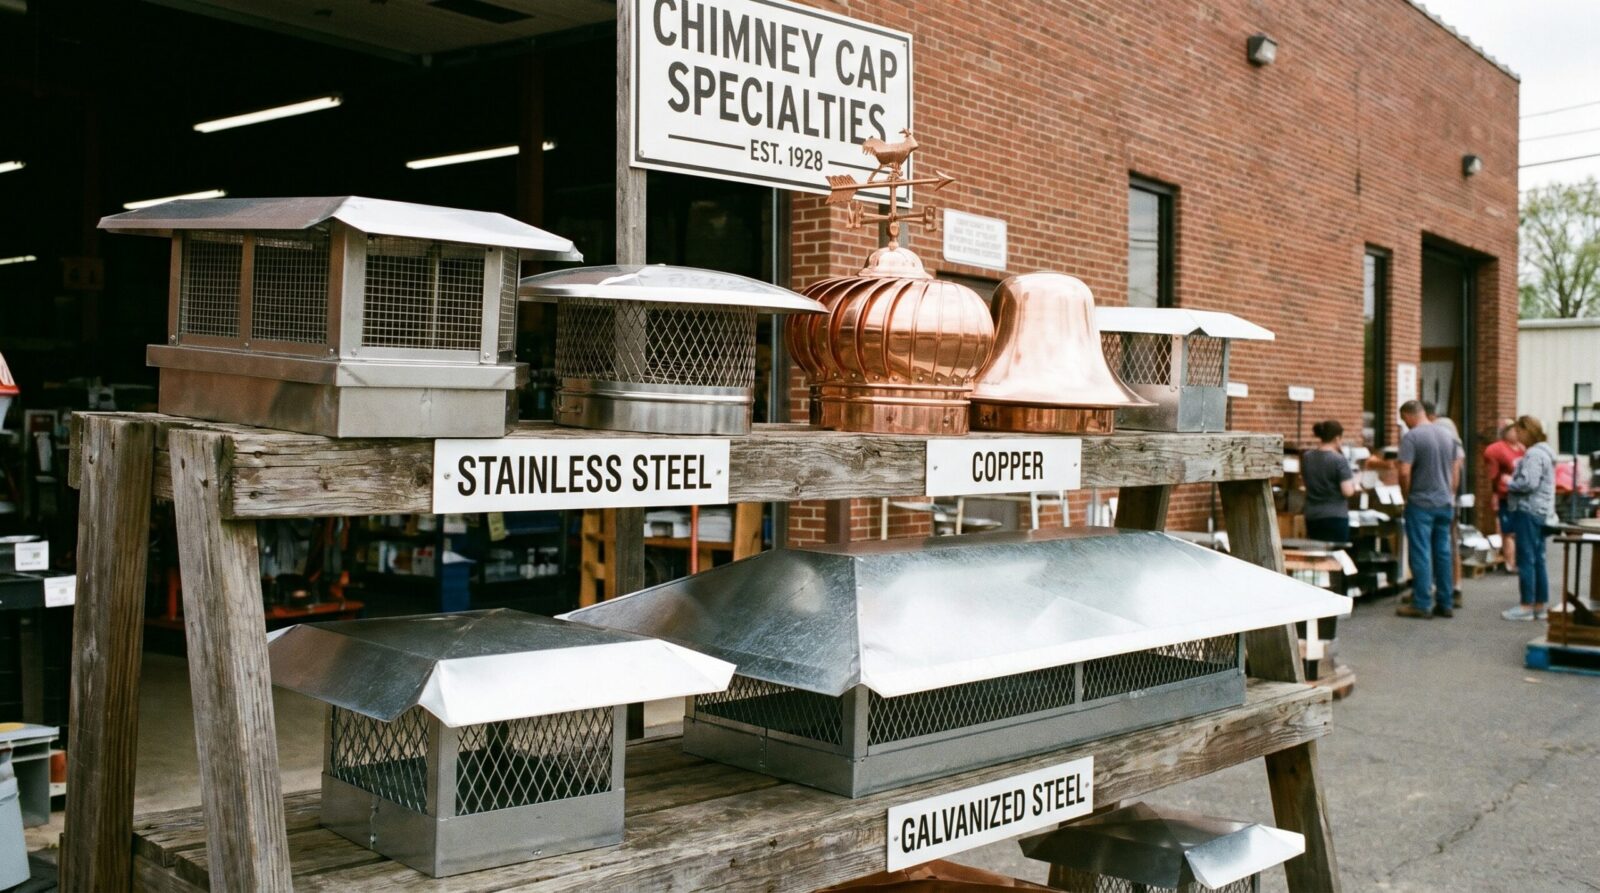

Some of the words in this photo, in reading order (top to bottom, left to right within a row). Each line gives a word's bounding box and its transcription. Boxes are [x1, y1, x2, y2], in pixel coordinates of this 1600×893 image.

[653, 0, 823, 78] CHIMNEY
[835, 39, 898, 94] CAP
[667, 61, 886, 146] SPECIALTIES
[750, 139, 782, 165] EST.
[788, 146, 823, 171] 1928
[457, 454, 622, 497] STAINLESS
[632, 454, 712, 492] STEEL
[972, 451, 1044, 482] COPPER
[901, 788, 1026, 853] GALVANIZED
[1032, 773, 1085, 816] STEEL
